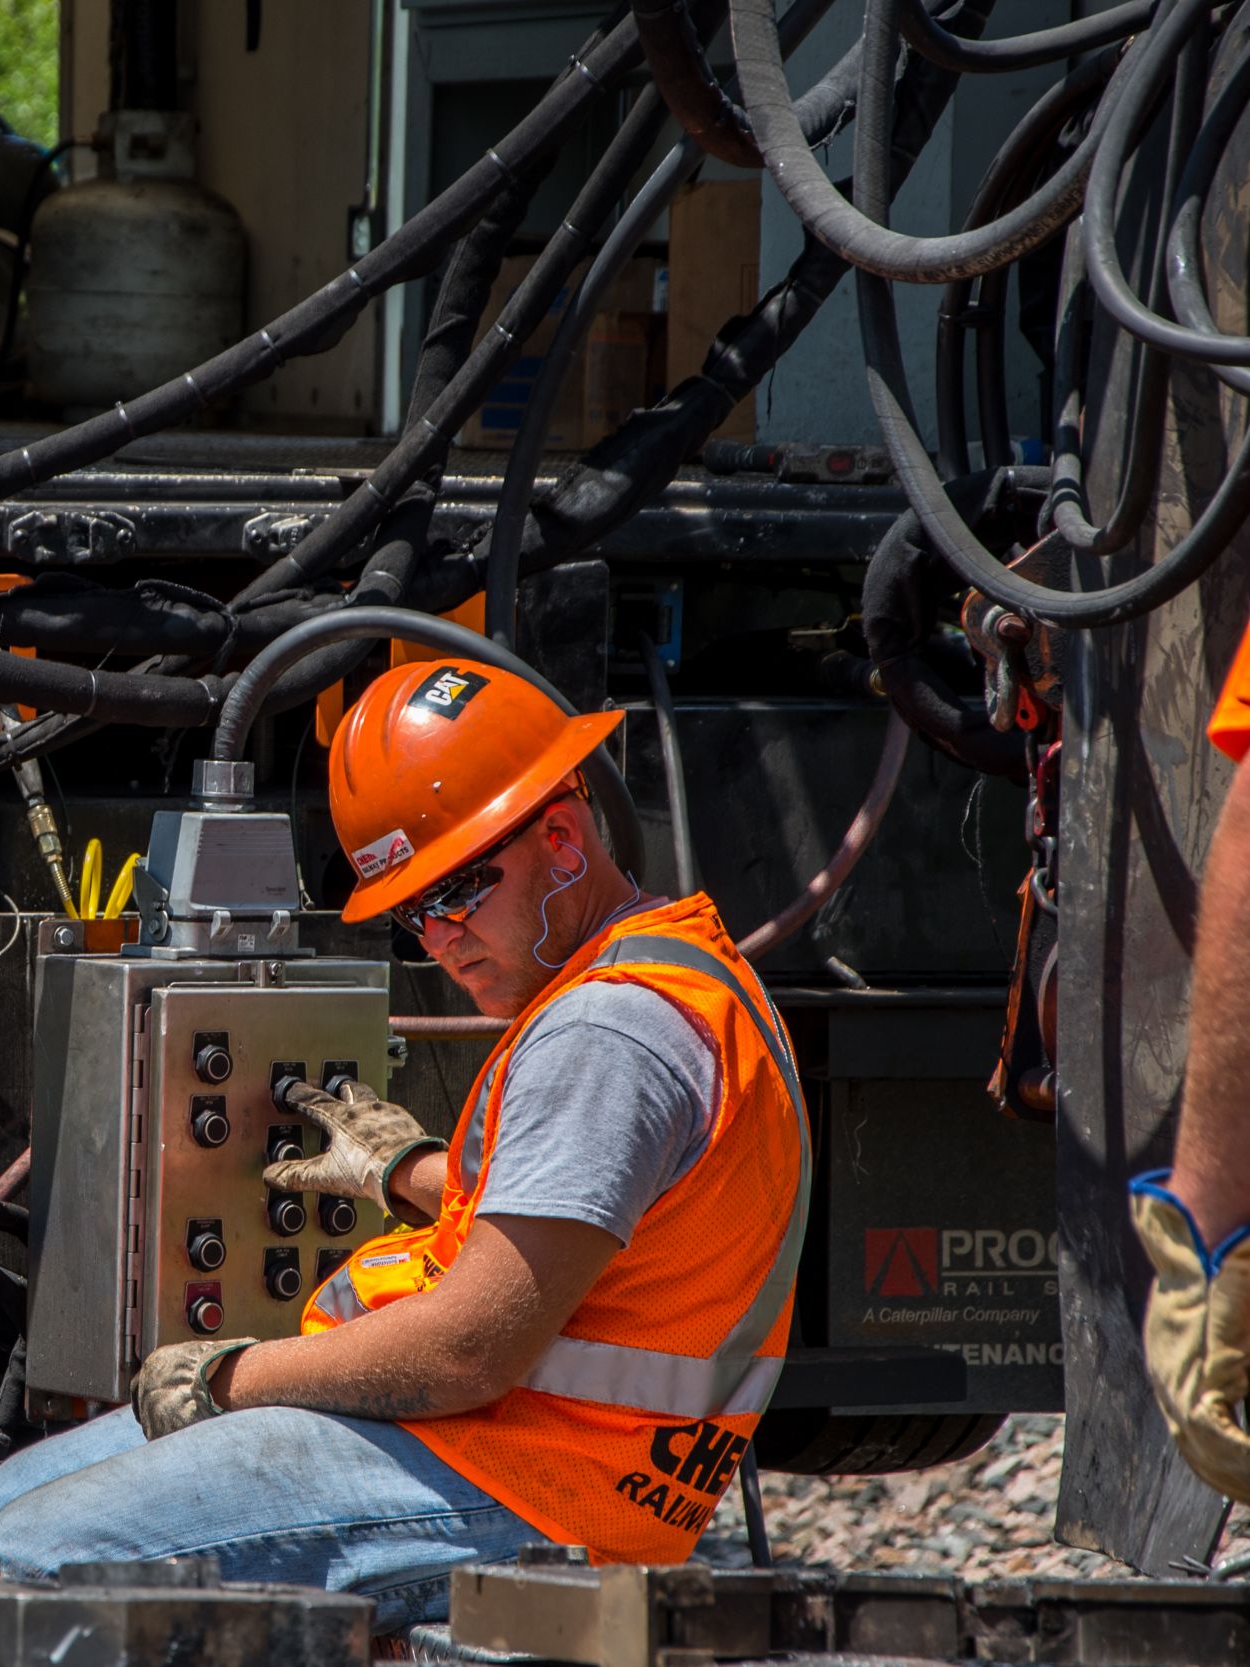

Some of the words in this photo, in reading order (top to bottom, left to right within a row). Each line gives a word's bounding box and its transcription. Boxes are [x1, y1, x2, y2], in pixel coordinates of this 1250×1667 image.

[425, 671, 469, 706] CAT
[943, 1281, 1015, 1296] RAIL
[862, 1307, 875, 1324] A
[879, 1307, 959, 1325] Caterpillar
[962, 1306, 1040, 1325] Company
[933, 1342, 1064, 1366] TENANC
